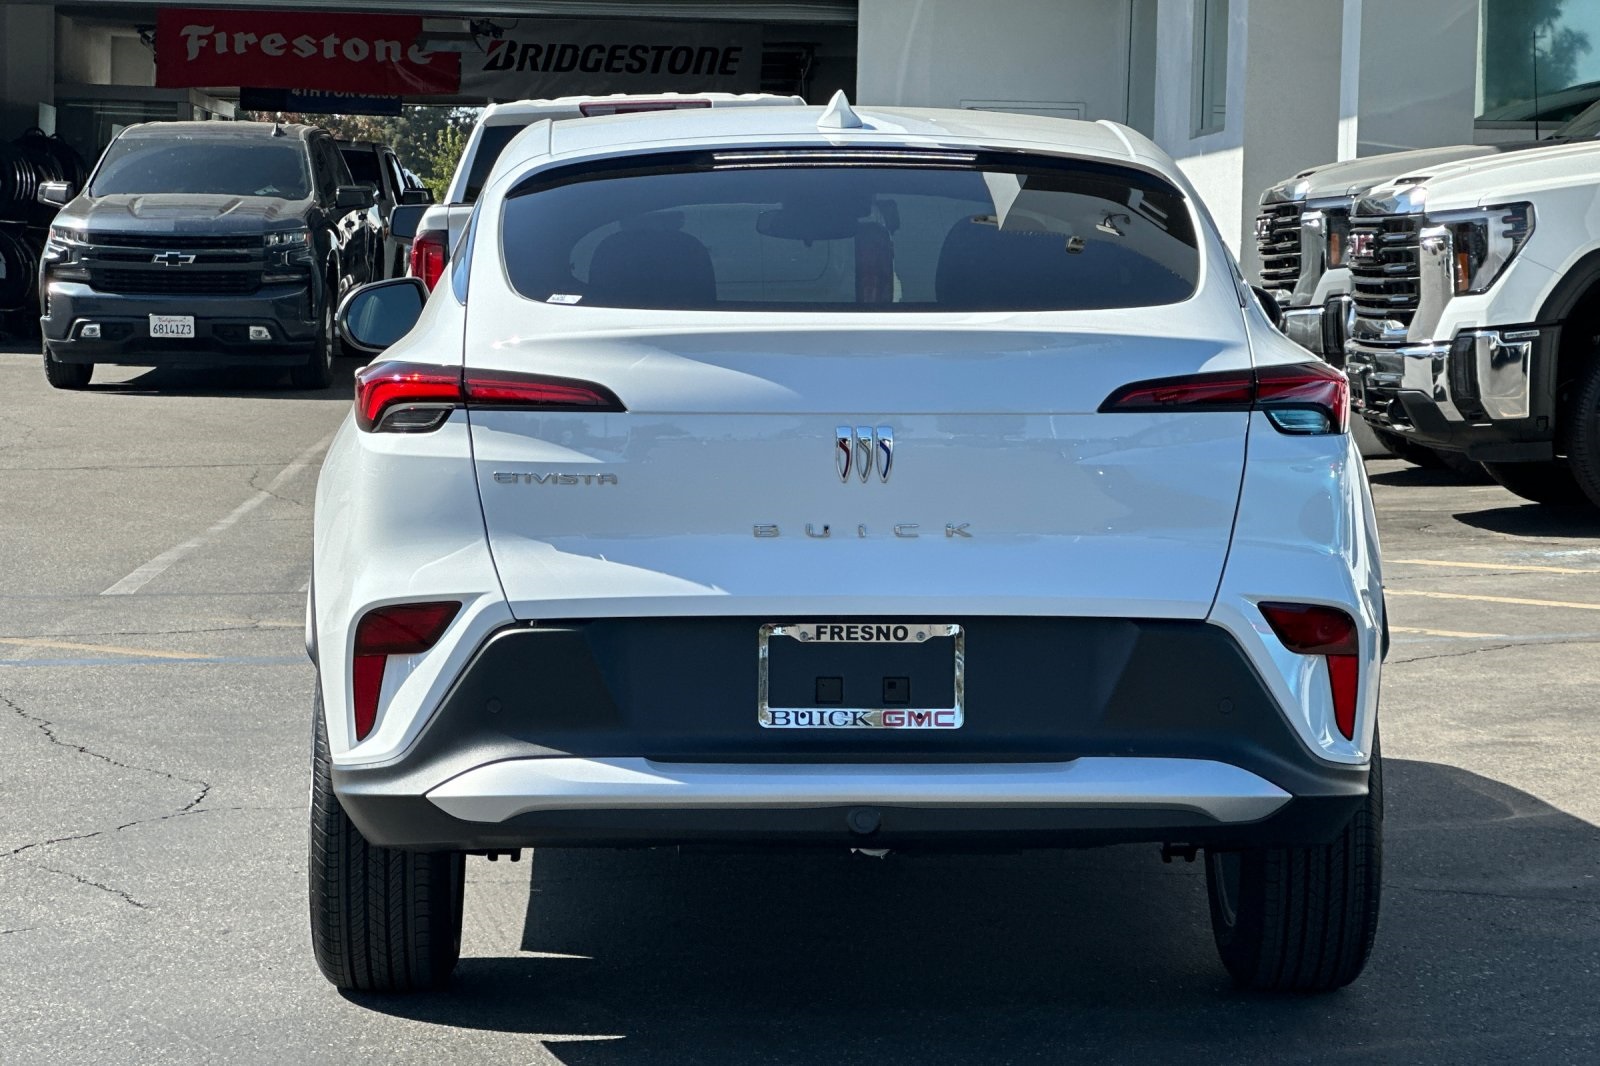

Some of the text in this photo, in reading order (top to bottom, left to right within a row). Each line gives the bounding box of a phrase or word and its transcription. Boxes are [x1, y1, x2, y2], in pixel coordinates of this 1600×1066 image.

[179, 24, 433, 65] Firestone
[482, 40, 742, 76] BRIDGESTONE
[153, 324, 192, 334] 68141Z3
[493, 471, 618, 485] ENVISTA
[753, 523, 974, 539] BUICK
[815, 625, 909, 641] FRESNO
[768, 710, 955, 727] BUICK GMC
